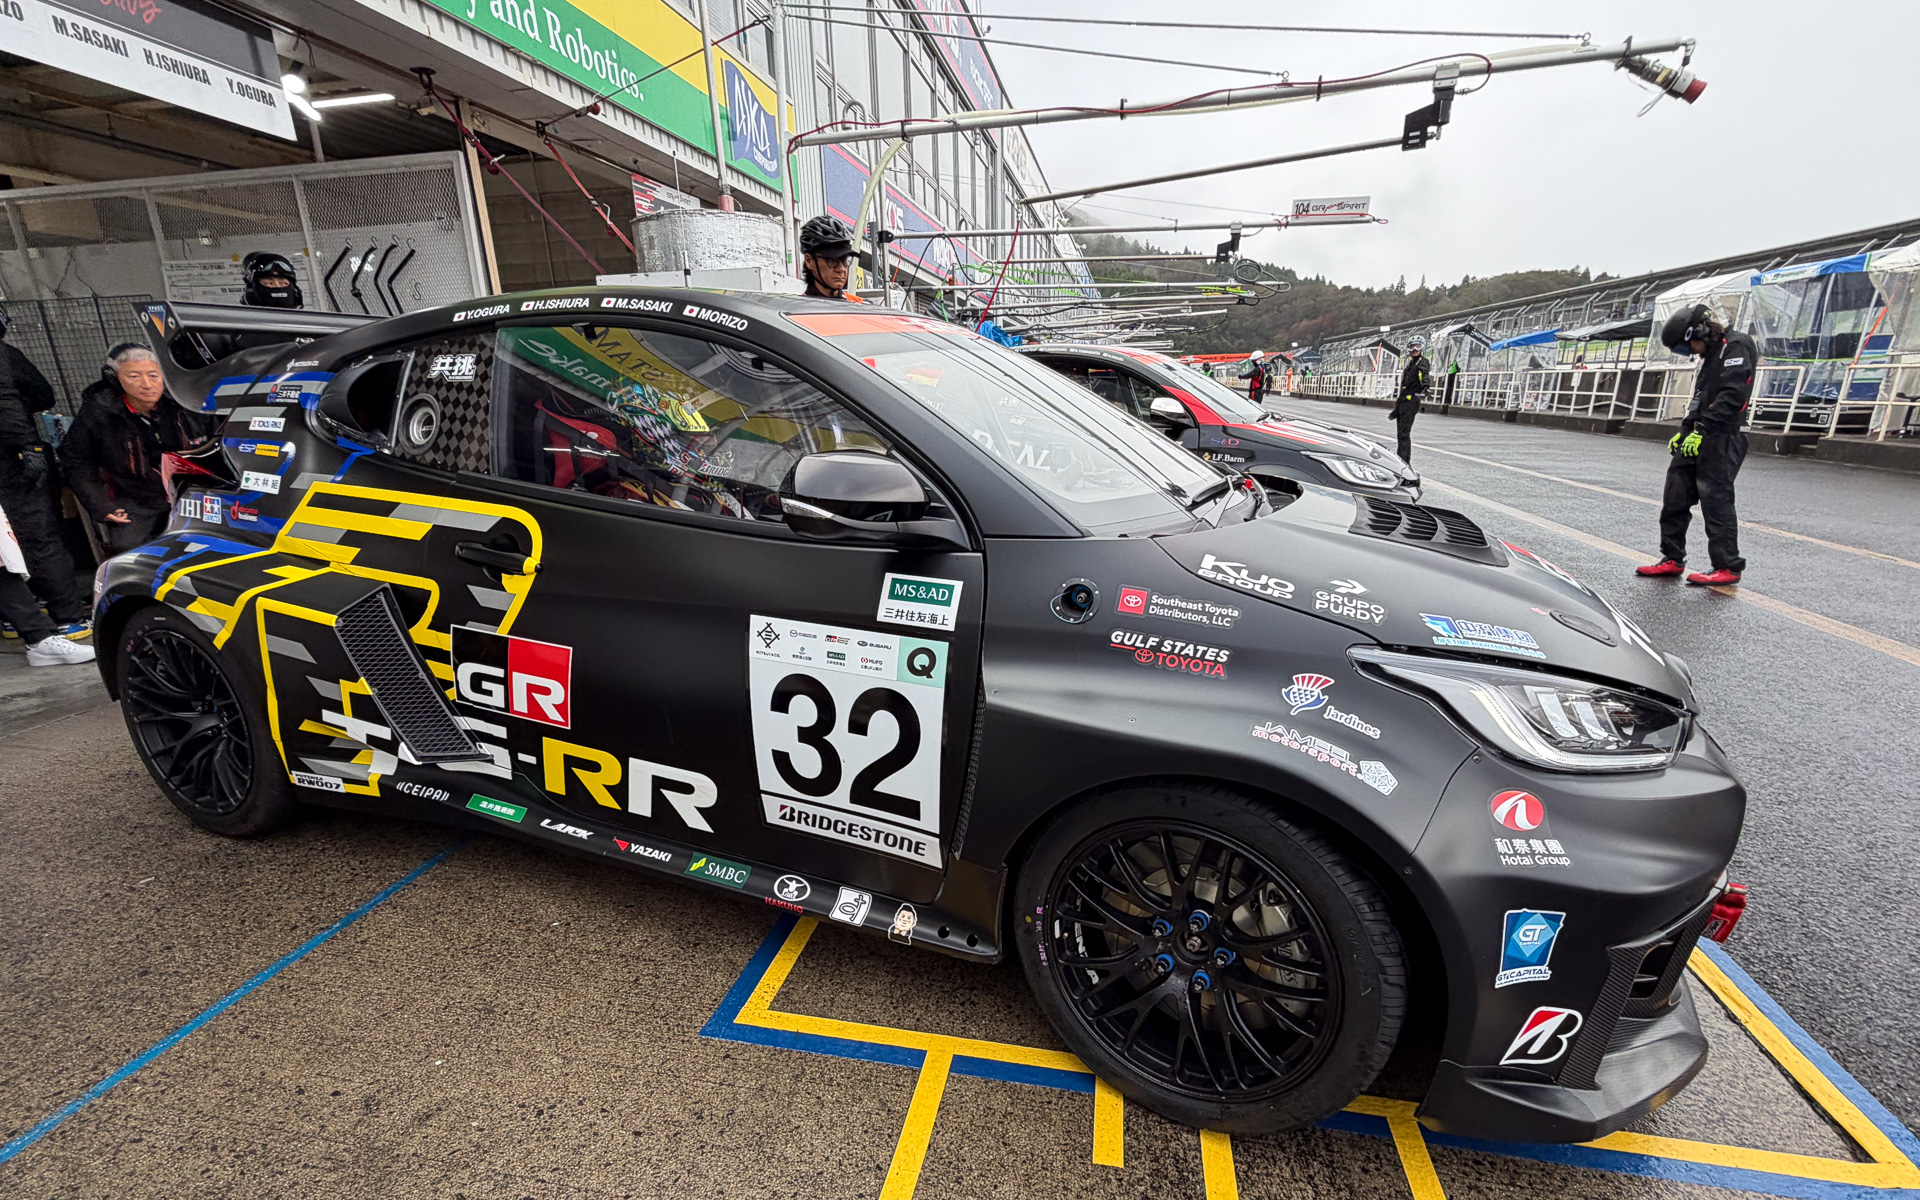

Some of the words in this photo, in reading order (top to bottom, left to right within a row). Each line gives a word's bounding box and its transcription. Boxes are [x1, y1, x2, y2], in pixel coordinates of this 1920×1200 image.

[51, 14, 130, 58] M.SASAKI
[143, 47, 212, 86] H.ISHIURA
[226, 77, 277, 109] Y.OGURA
[543, 7, 644, 102] Robotics.
[467, 304, 510, 319] Y.OGURA
[534, 298, 590, 310] H.ISHIURA
[615, 298, 673, 313] M.SASAKI
[697, 308, 749, 331] MORIZO
[179, 498, 202, 519] IHI
[894, 583, 949, 601] MS&AD
[1197, 568, 1293, 600] GROUP
[1151, 595, 1203, 611] Southeast
[1204, 603, 1239, 617] Toyota
[1315, 591, 1385, 614] GRUPO
[1315, 600, 1384, 624] PURDY
[883, 607, 949, 626] 三井住友海上
[1148, 605, 1210, 624] Distributors,
[1211, 616, 1232, 627] LLC
[869, 642, 892, 650] SUBARU
[1110, 630, 1159, 649] GULF
[1161, 640, 1230, 662] STATES
[906, 646, 937, 679] Q
[1156, 652, 1225, 677] TOYOTA
[456, 660, 567, 723] GR
[1324, 706, 1381, 738] Jardines
[770, 673, 921, 821] 32
[297, 778, 342, 790] RW007
[778, 804, 927, 857] BRIDGESTONE
[629, 842, 672, 862] YAZAKI
[1494, 838, 1566, 855] 和泰集團
[1500, 854, 1534, 866] Hotai
[1534, 854, 1571, 867] Group
[704, 862, 747, 884] SMBC
[764, 896, 804, 914] HAKUHO
[1518, 924, 1549, 942] GT
